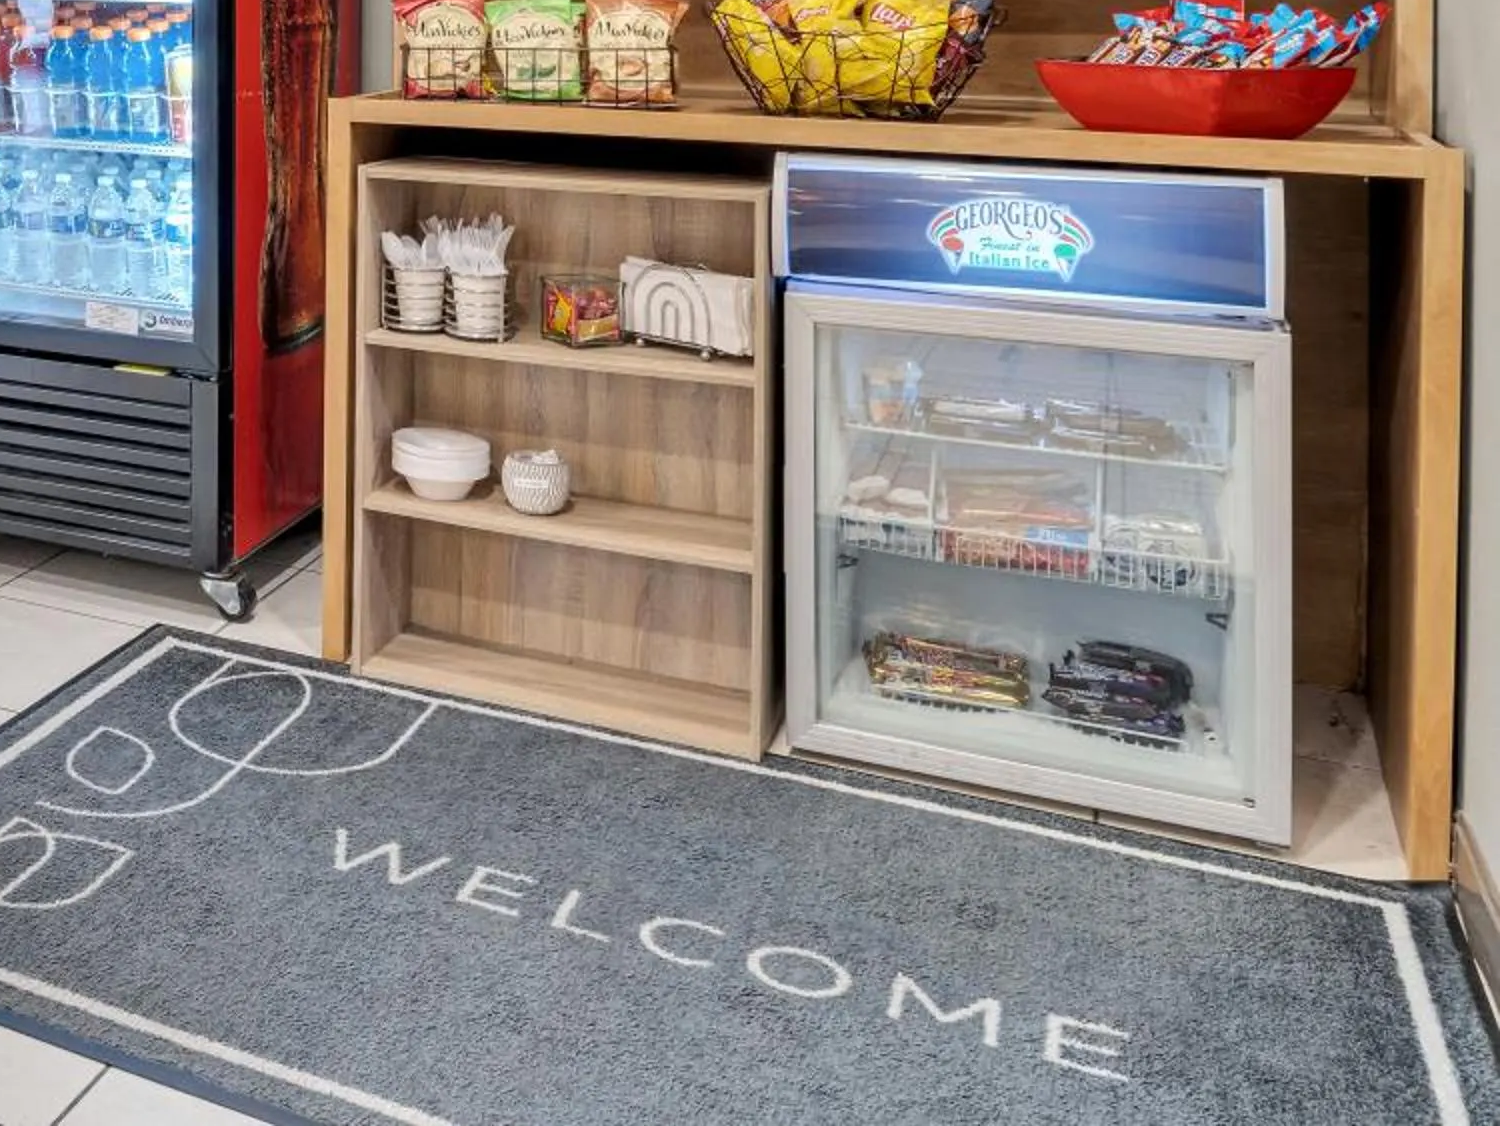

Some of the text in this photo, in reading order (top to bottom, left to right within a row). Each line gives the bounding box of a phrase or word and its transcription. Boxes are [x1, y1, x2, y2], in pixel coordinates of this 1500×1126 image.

[969, 251, 1050, 269] Italian Ice
[333, 827, 1130, 1082] WELCOME
